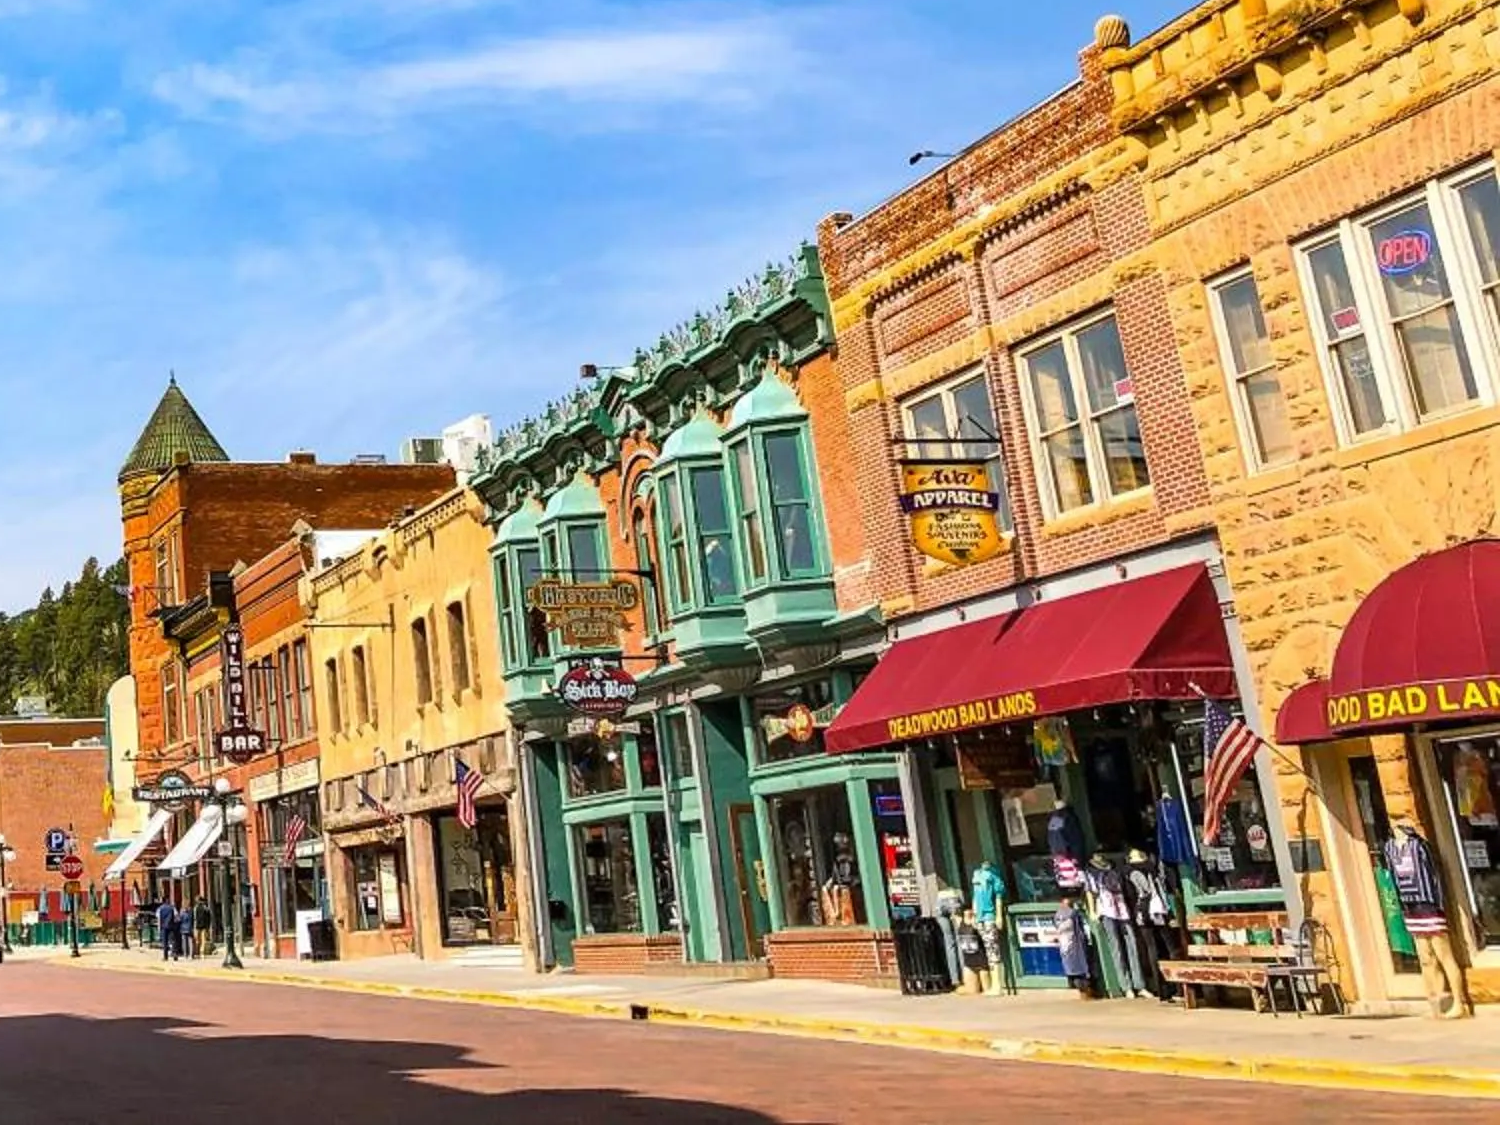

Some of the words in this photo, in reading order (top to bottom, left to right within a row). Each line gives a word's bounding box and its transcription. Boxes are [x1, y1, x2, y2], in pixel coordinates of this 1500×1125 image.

[1380, 237, 1426, 266] OPEN
[913, 490, 993, 508] APPAREL
[563, 679, 603, 701] Sick
[1367, 686, 1427, 719] BAD
[888, 708, 957, 740] DEADWOOD
[959, 701, 987, 726] BAD
[988, 691, 1037, 720] LANDS
[221, 736, 262, 752] BAR
[138, 787, 210, 799] RESTAURANT
[52, 832, 63, 848] P
[63, 862, 81, 873] STOP
